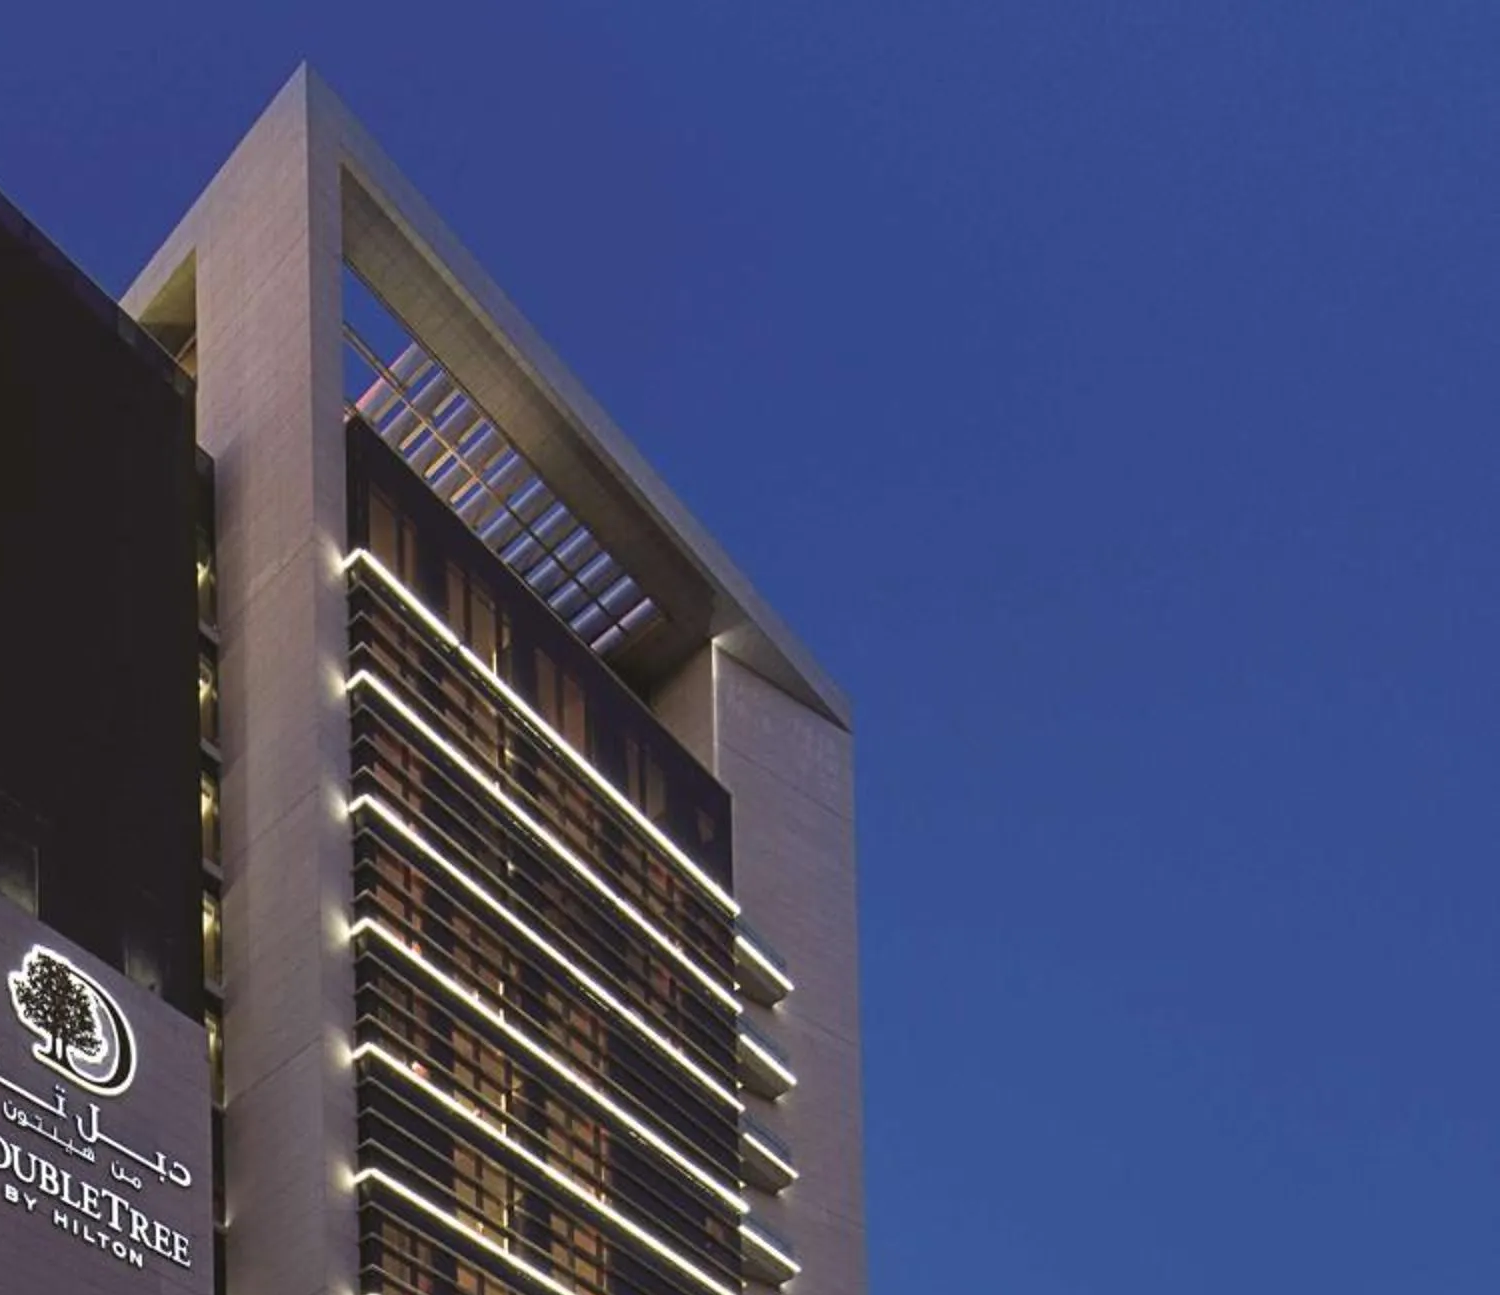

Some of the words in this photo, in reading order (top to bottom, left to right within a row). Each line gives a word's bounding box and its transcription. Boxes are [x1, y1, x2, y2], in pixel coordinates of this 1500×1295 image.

[2, 1099, 96, 1163] هيلتون
[110, 1159, 143, 1190] من
[4, 1183, 38, 1212] BY
[53, 1205, 144, 1268] HILTON
